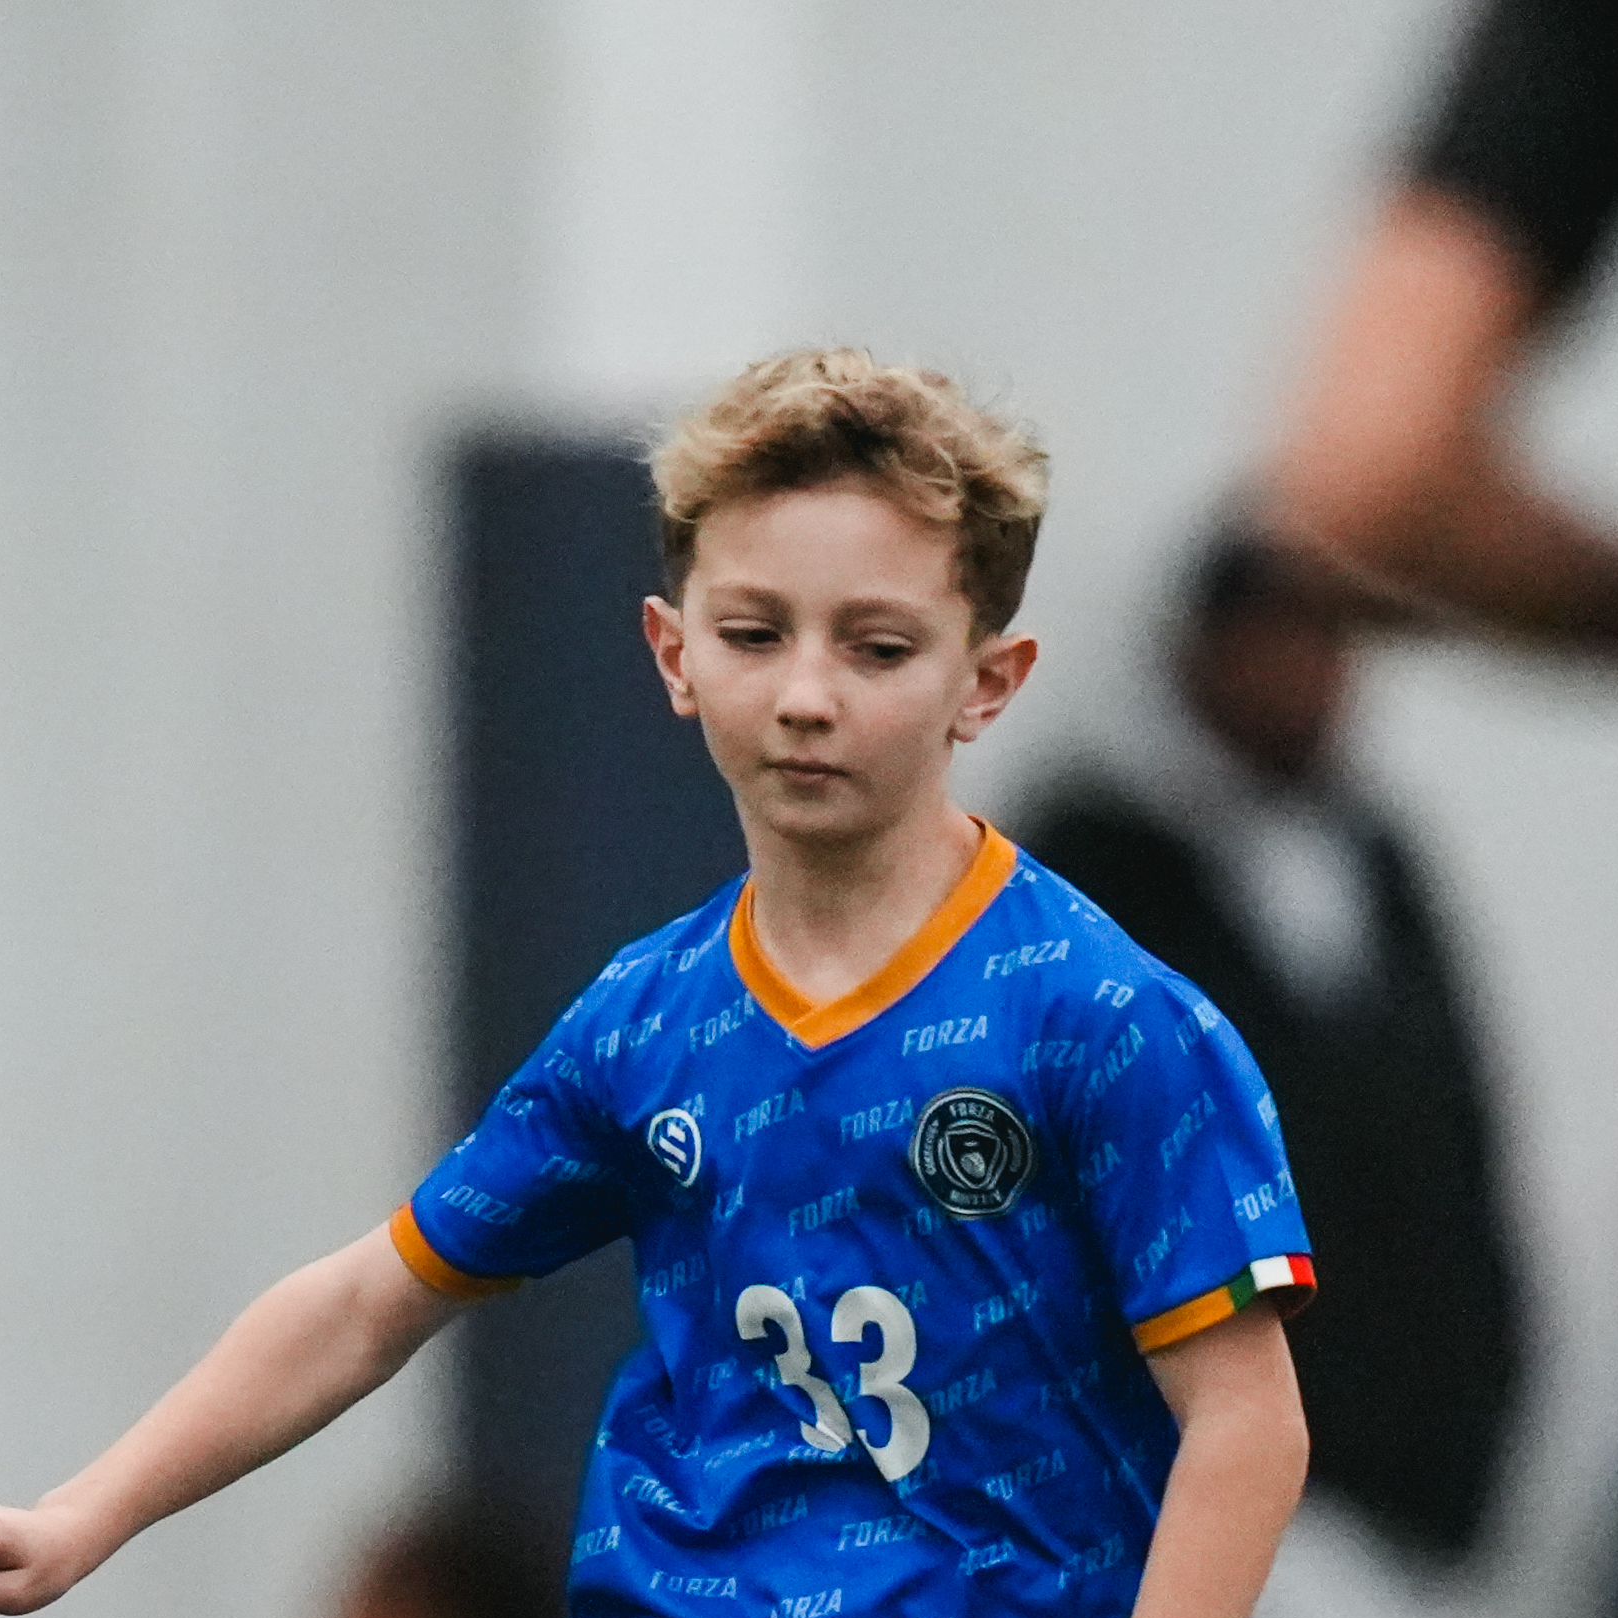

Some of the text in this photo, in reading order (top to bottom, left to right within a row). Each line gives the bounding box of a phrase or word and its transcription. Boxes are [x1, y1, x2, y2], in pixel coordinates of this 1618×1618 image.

[983, 938, 1071, 980] FORZA
[901, 1014, 988, 1058] FORZA
[734, 1087, 805, 1144] FORZA
[840, 1096, 915, 1147] FORZA
[735, 1284, 931, 1483] 33
[928, 1367, 997, 1417] ORZA
[837, 1514, 927, 1552] FORZA
[650, 1570, 738, 1600] FORZA
